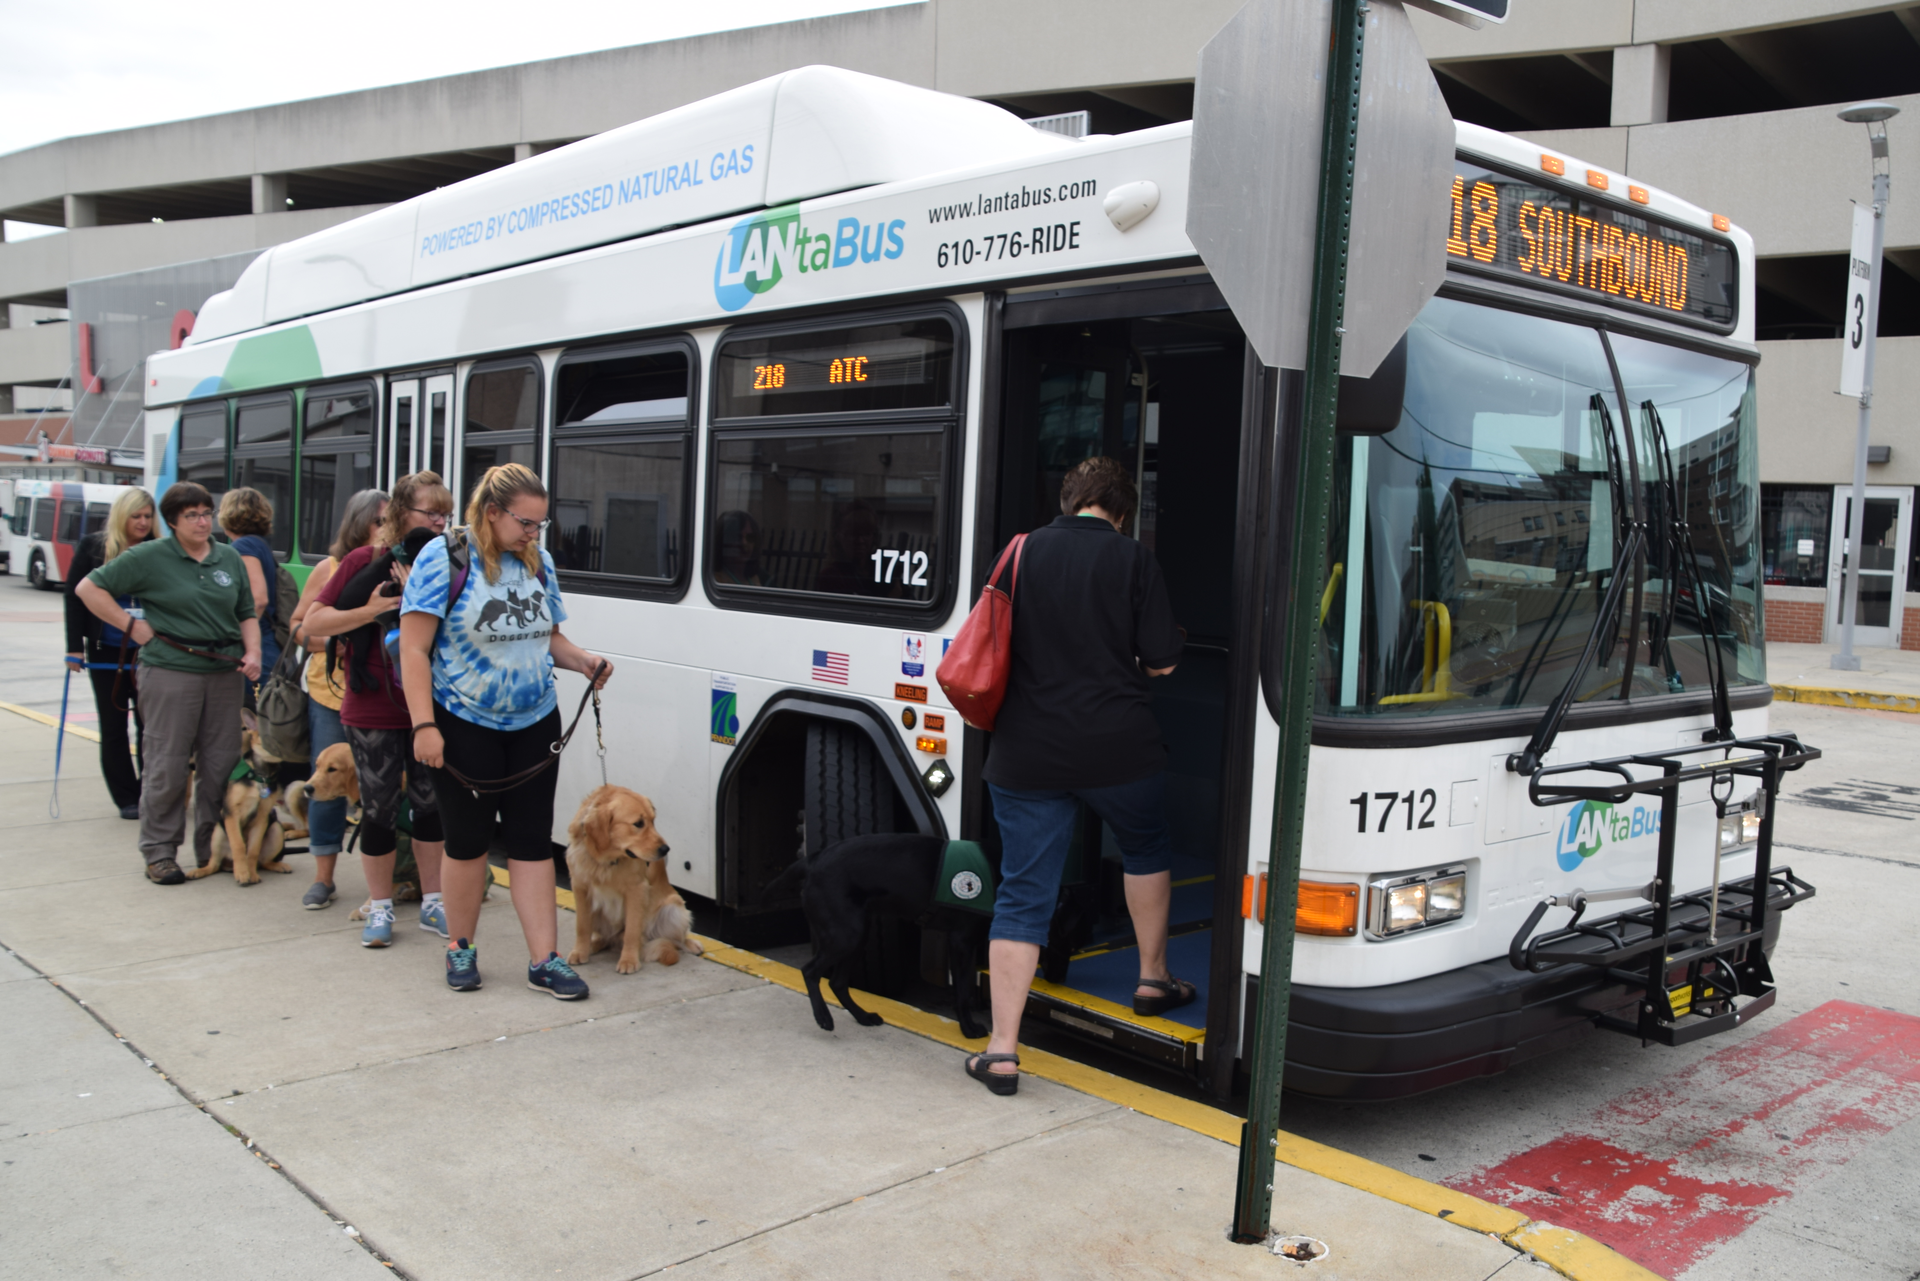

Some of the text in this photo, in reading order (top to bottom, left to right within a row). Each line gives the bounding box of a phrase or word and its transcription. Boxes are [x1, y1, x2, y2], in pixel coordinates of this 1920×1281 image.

[420, 144, 755, 258] POWERED BY COMPRESSED NATURAL GAS
[928, 178, 1097, 224] www.lantabus.com
[937, 221, 1081, 269] 610-776-RIDE
[1518, 200, 1688, 311] SOUTHBOUND
[1851, 293, 1864, 350] 3
[753, 356, 868, 390] 218 ATC
[871, 548, 929, 587] 1712
[489, 633, 529, 642] DOGGY
[896, 685, 927, 701] KNEELING
[925, 716, 944, 729] RAMP
[1349, 788, 1437, 834] 1712
